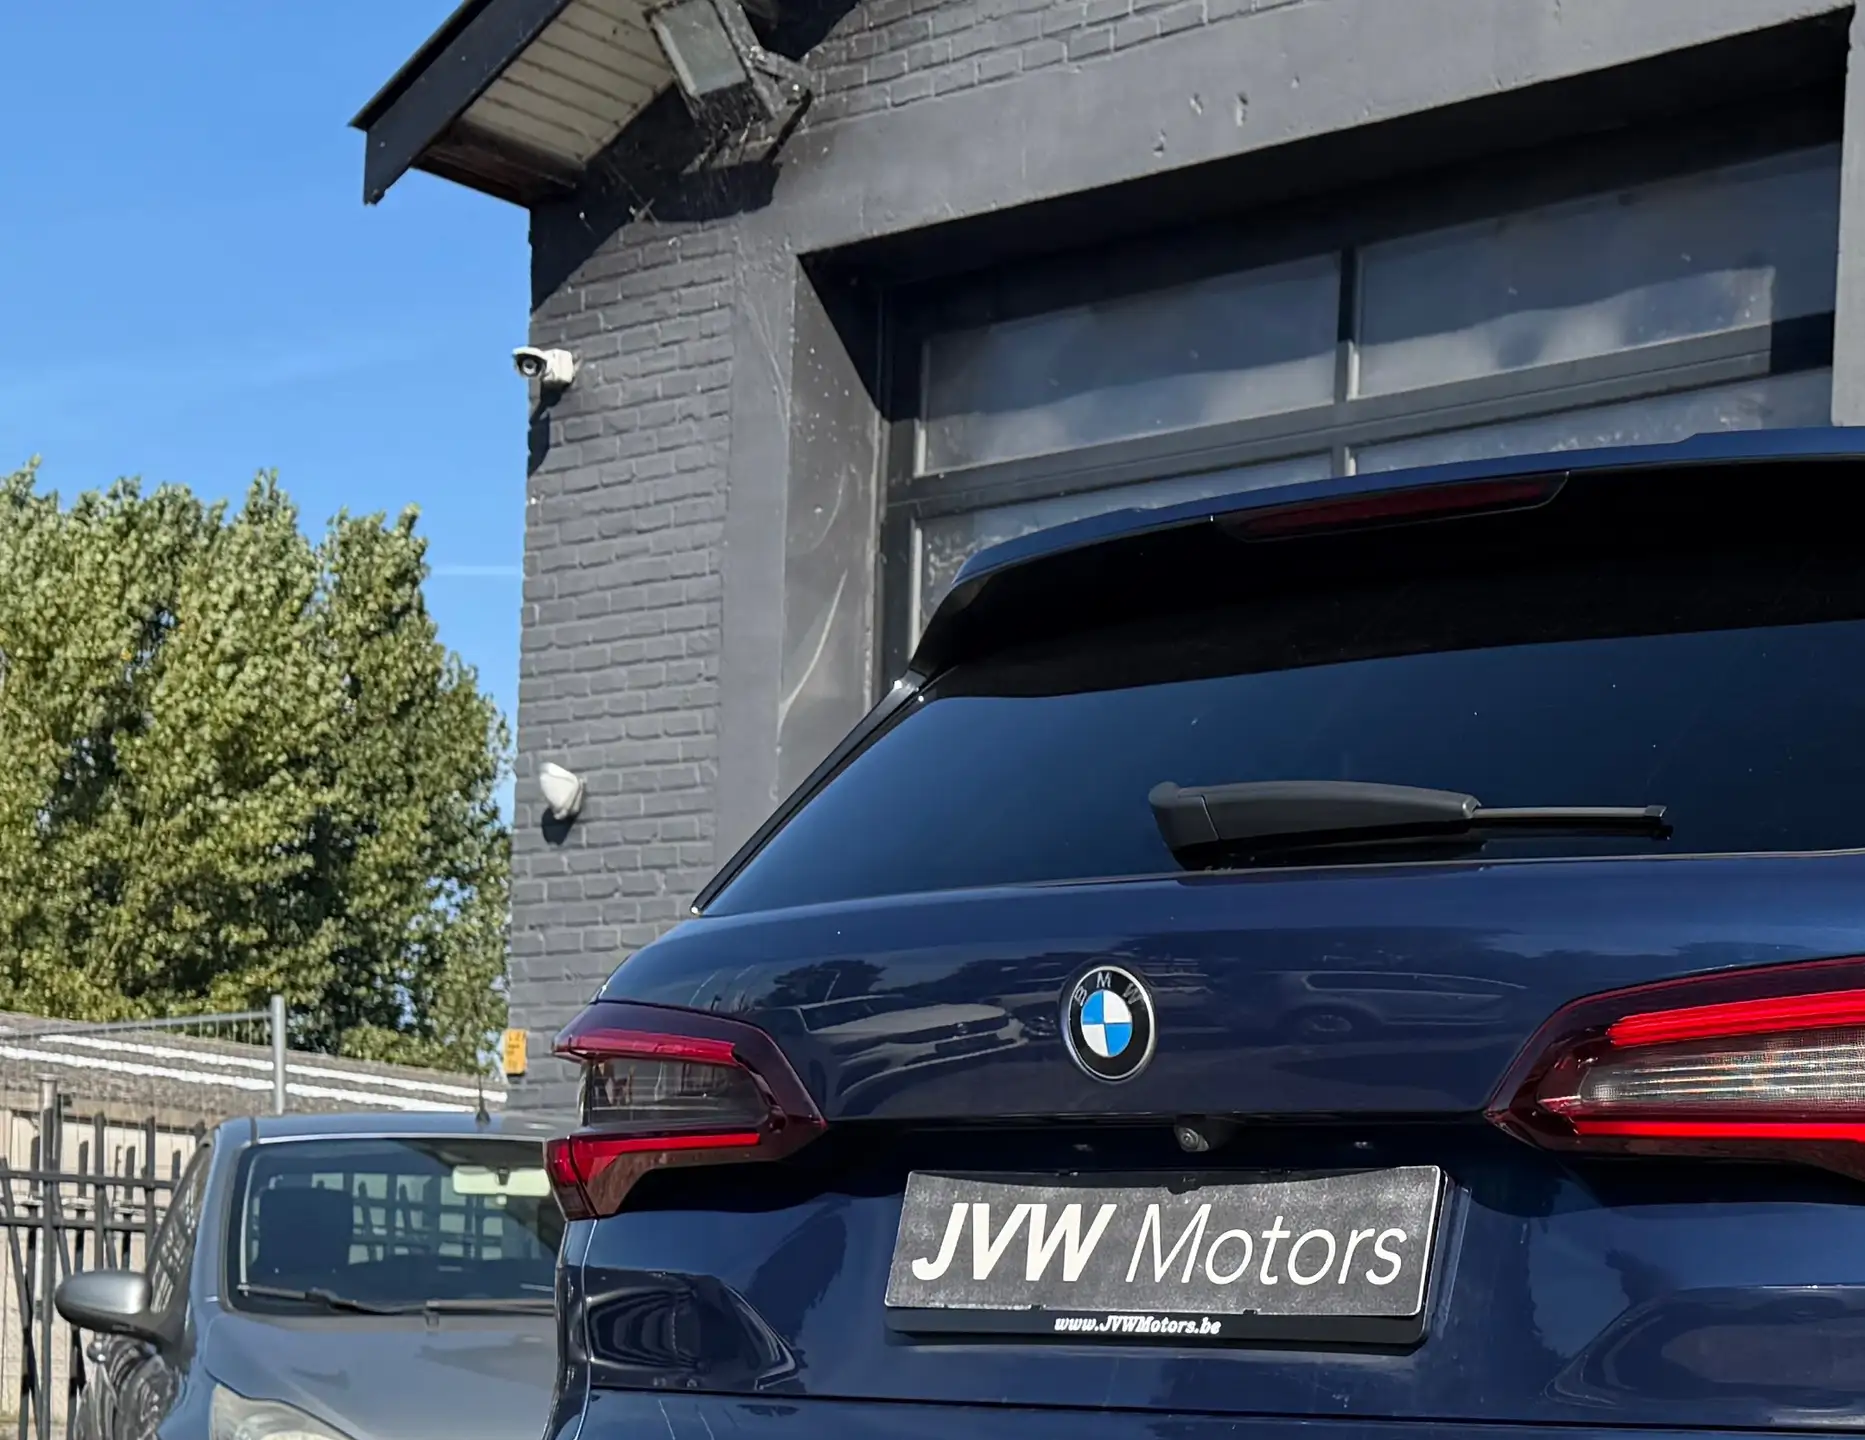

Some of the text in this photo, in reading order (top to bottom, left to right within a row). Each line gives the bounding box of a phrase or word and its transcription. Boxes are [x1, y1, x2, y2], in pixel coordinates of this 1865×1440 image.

[1073, 971, 1144, 1007] BMW
[911, 1202, 1407, 1286] JVW Motors
[1054, 1314, 1222, 1335] www.JVWMotors.be
